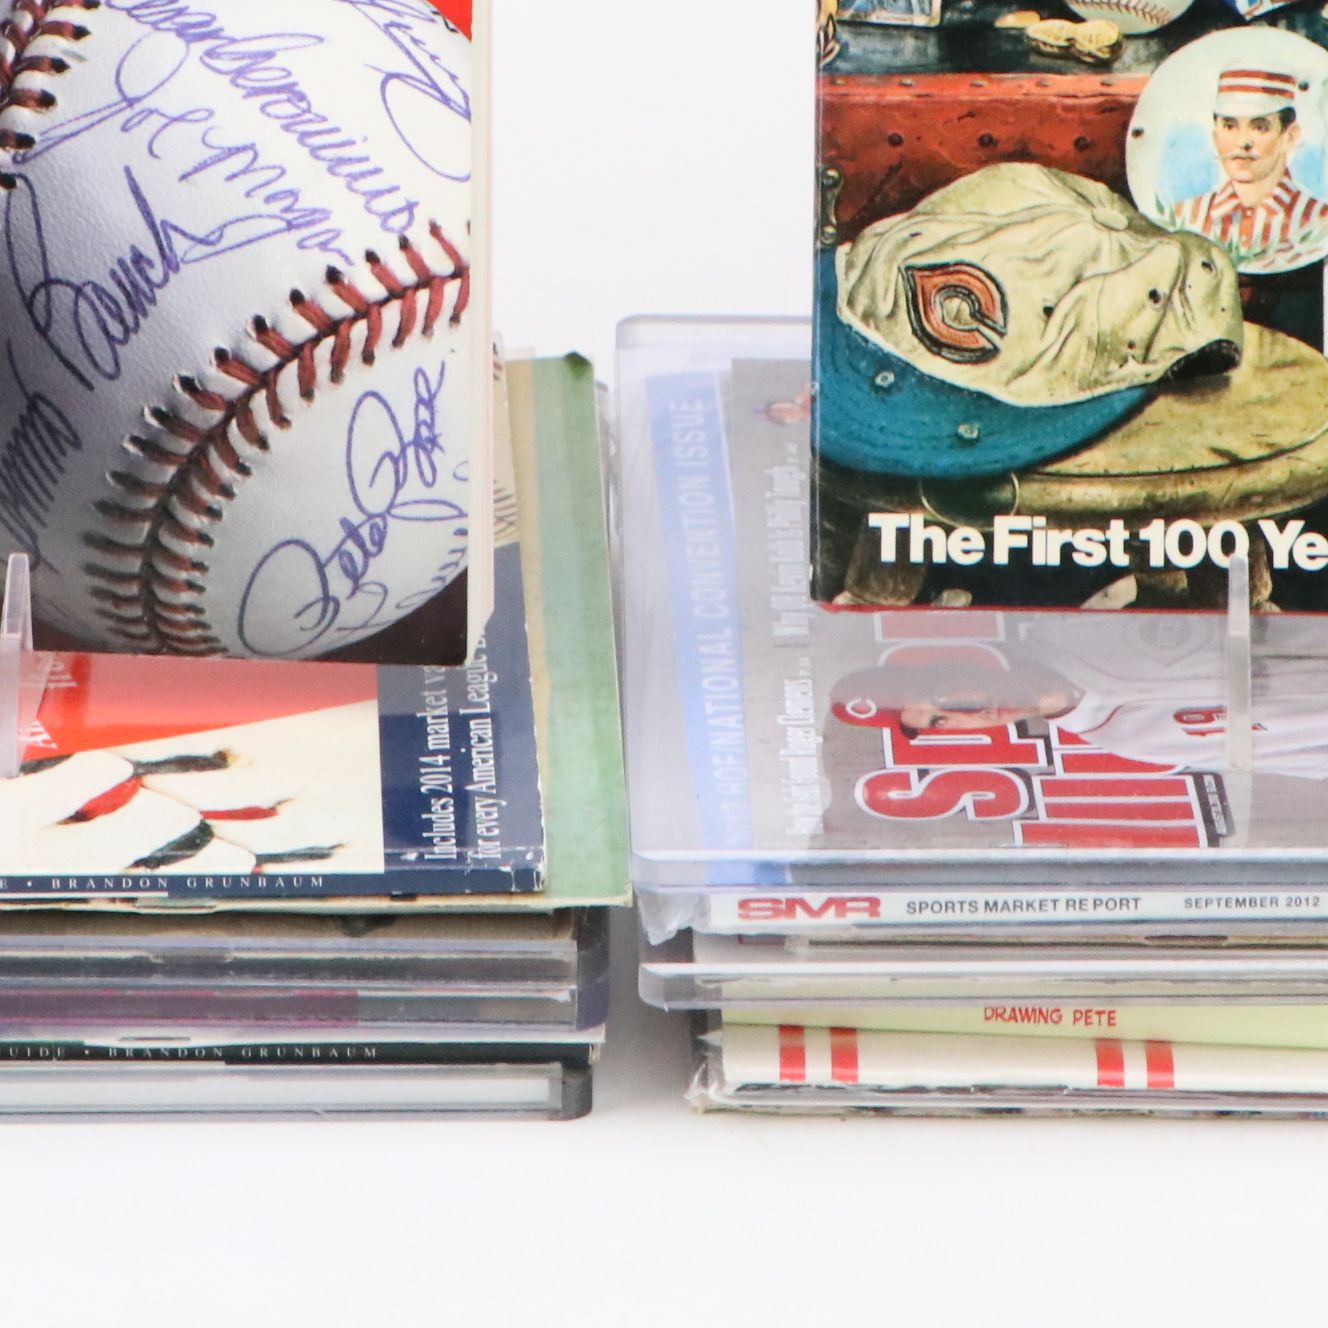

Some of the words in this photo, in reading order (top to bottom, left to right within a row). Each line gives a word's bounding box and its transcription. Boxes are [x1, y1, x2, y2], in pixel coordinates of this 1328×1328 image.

[667, 400, 709, 467] ISSUE
[674, 474, 732, 619] CONVENTION
[868, 513, 984, 566] The
[992, 515, 1135, 568] First
[1138, 517, 1249, 570] 100
[416, 688, 451, 750] market
[417, 754, 453, 794] 2014
[461, 718, 497, 794] American
[421, 796, 458, 861] Includes
[471, 796, 508, 838] every
[468, 840, 502, 860] for
[51, 875, 169, 891] BRANDON
[186, 875, 325, 889] GRUNBAUM
[737, 896, 882, 920] SMR
[906, 900, 979, 915] SPORTS
[984, 899, 1060, 914] MARKET
[1065, 898, 1142, 913] REPORT
[1184, 897, 1280, 910] SEPTEMBER
[1285, 897, 1321, 909] 2012
[984, 1006, 1063, 1025] DRAWING
[1073, 1009, 1118, 1026] PETE
[109, 1046, 224, 1059] BRANDON
[242, 1046, 378, 1059] GRUNBAUM
